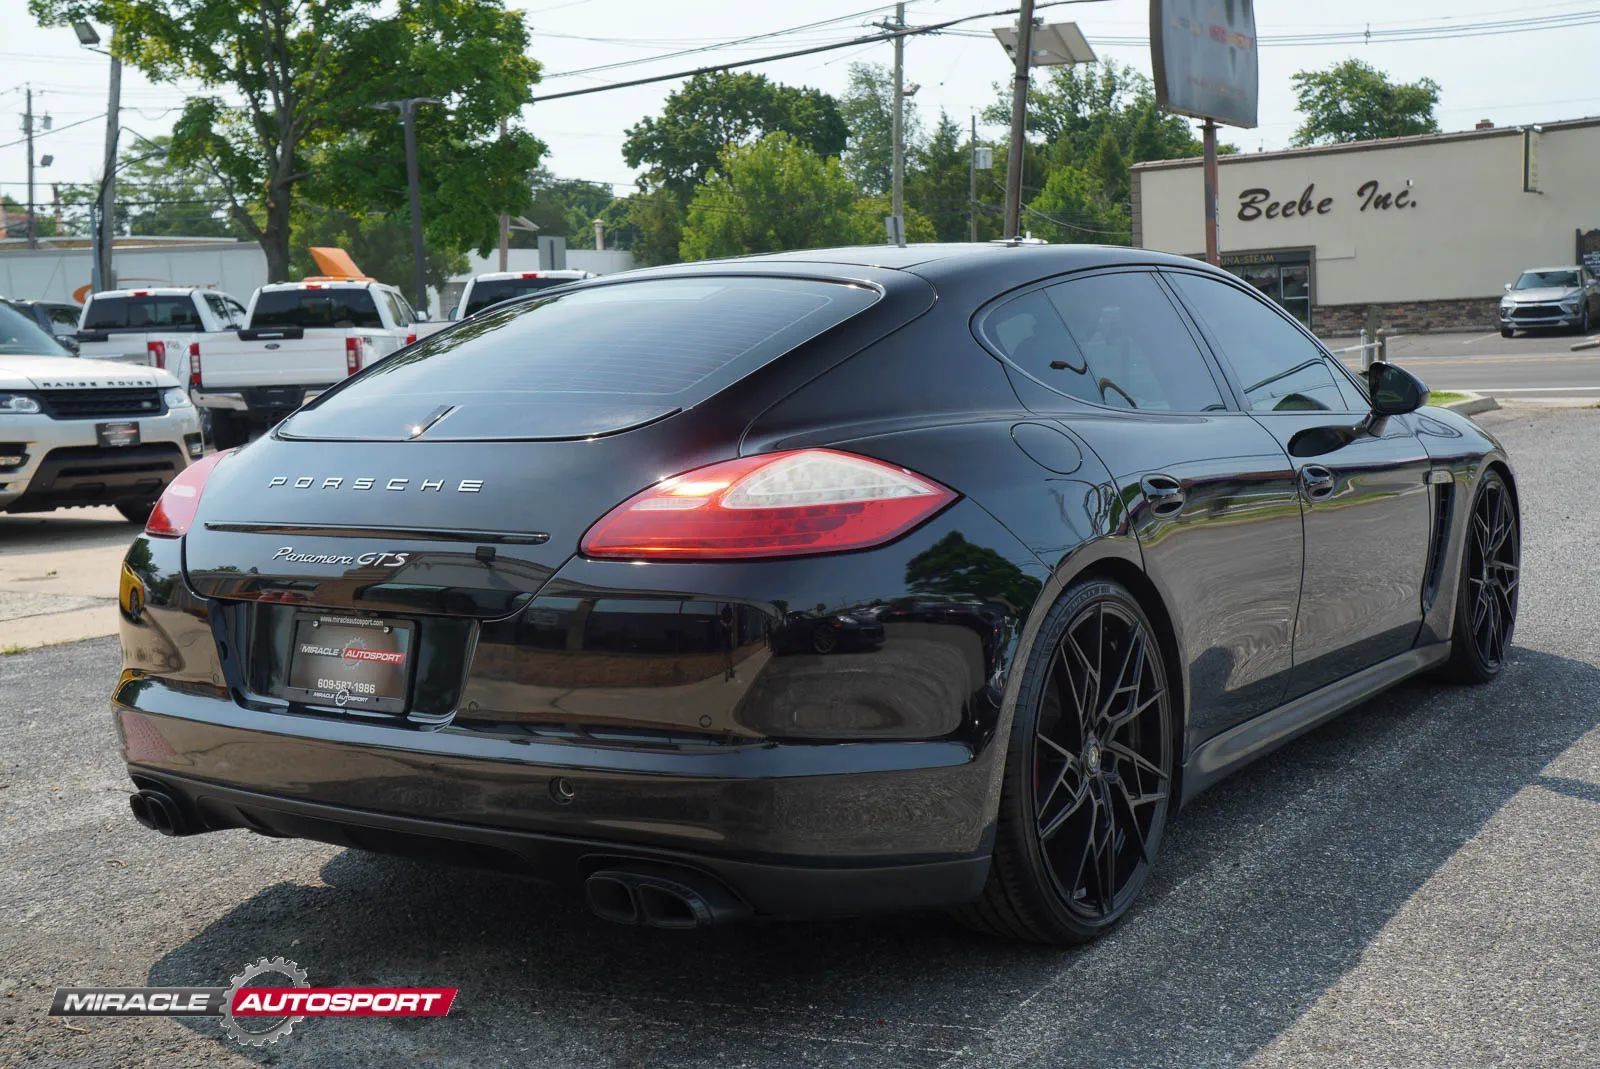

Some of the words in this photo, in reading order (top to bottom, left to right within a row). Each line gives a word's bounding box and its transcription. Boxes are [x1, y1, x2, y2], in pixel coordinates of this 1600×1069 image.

[1237, 183, 1333, 221] Beebe
[1357, 180, 1417, 212] Inc.
[268, 476, 484, 492] PORSCHE
[272, 547, 353, 565] Panamera
[356, 552, 409, 567] GTS
[320, 616, 384, 625] www.miracleautosport.com
[301, 645, 340, 656] MIRACLE
[346, 649, 401, 662] AUTOSPORT
[317, 679, 375, 693] 609-587-1986
[313, 691, 335, 699] MIRACLE
